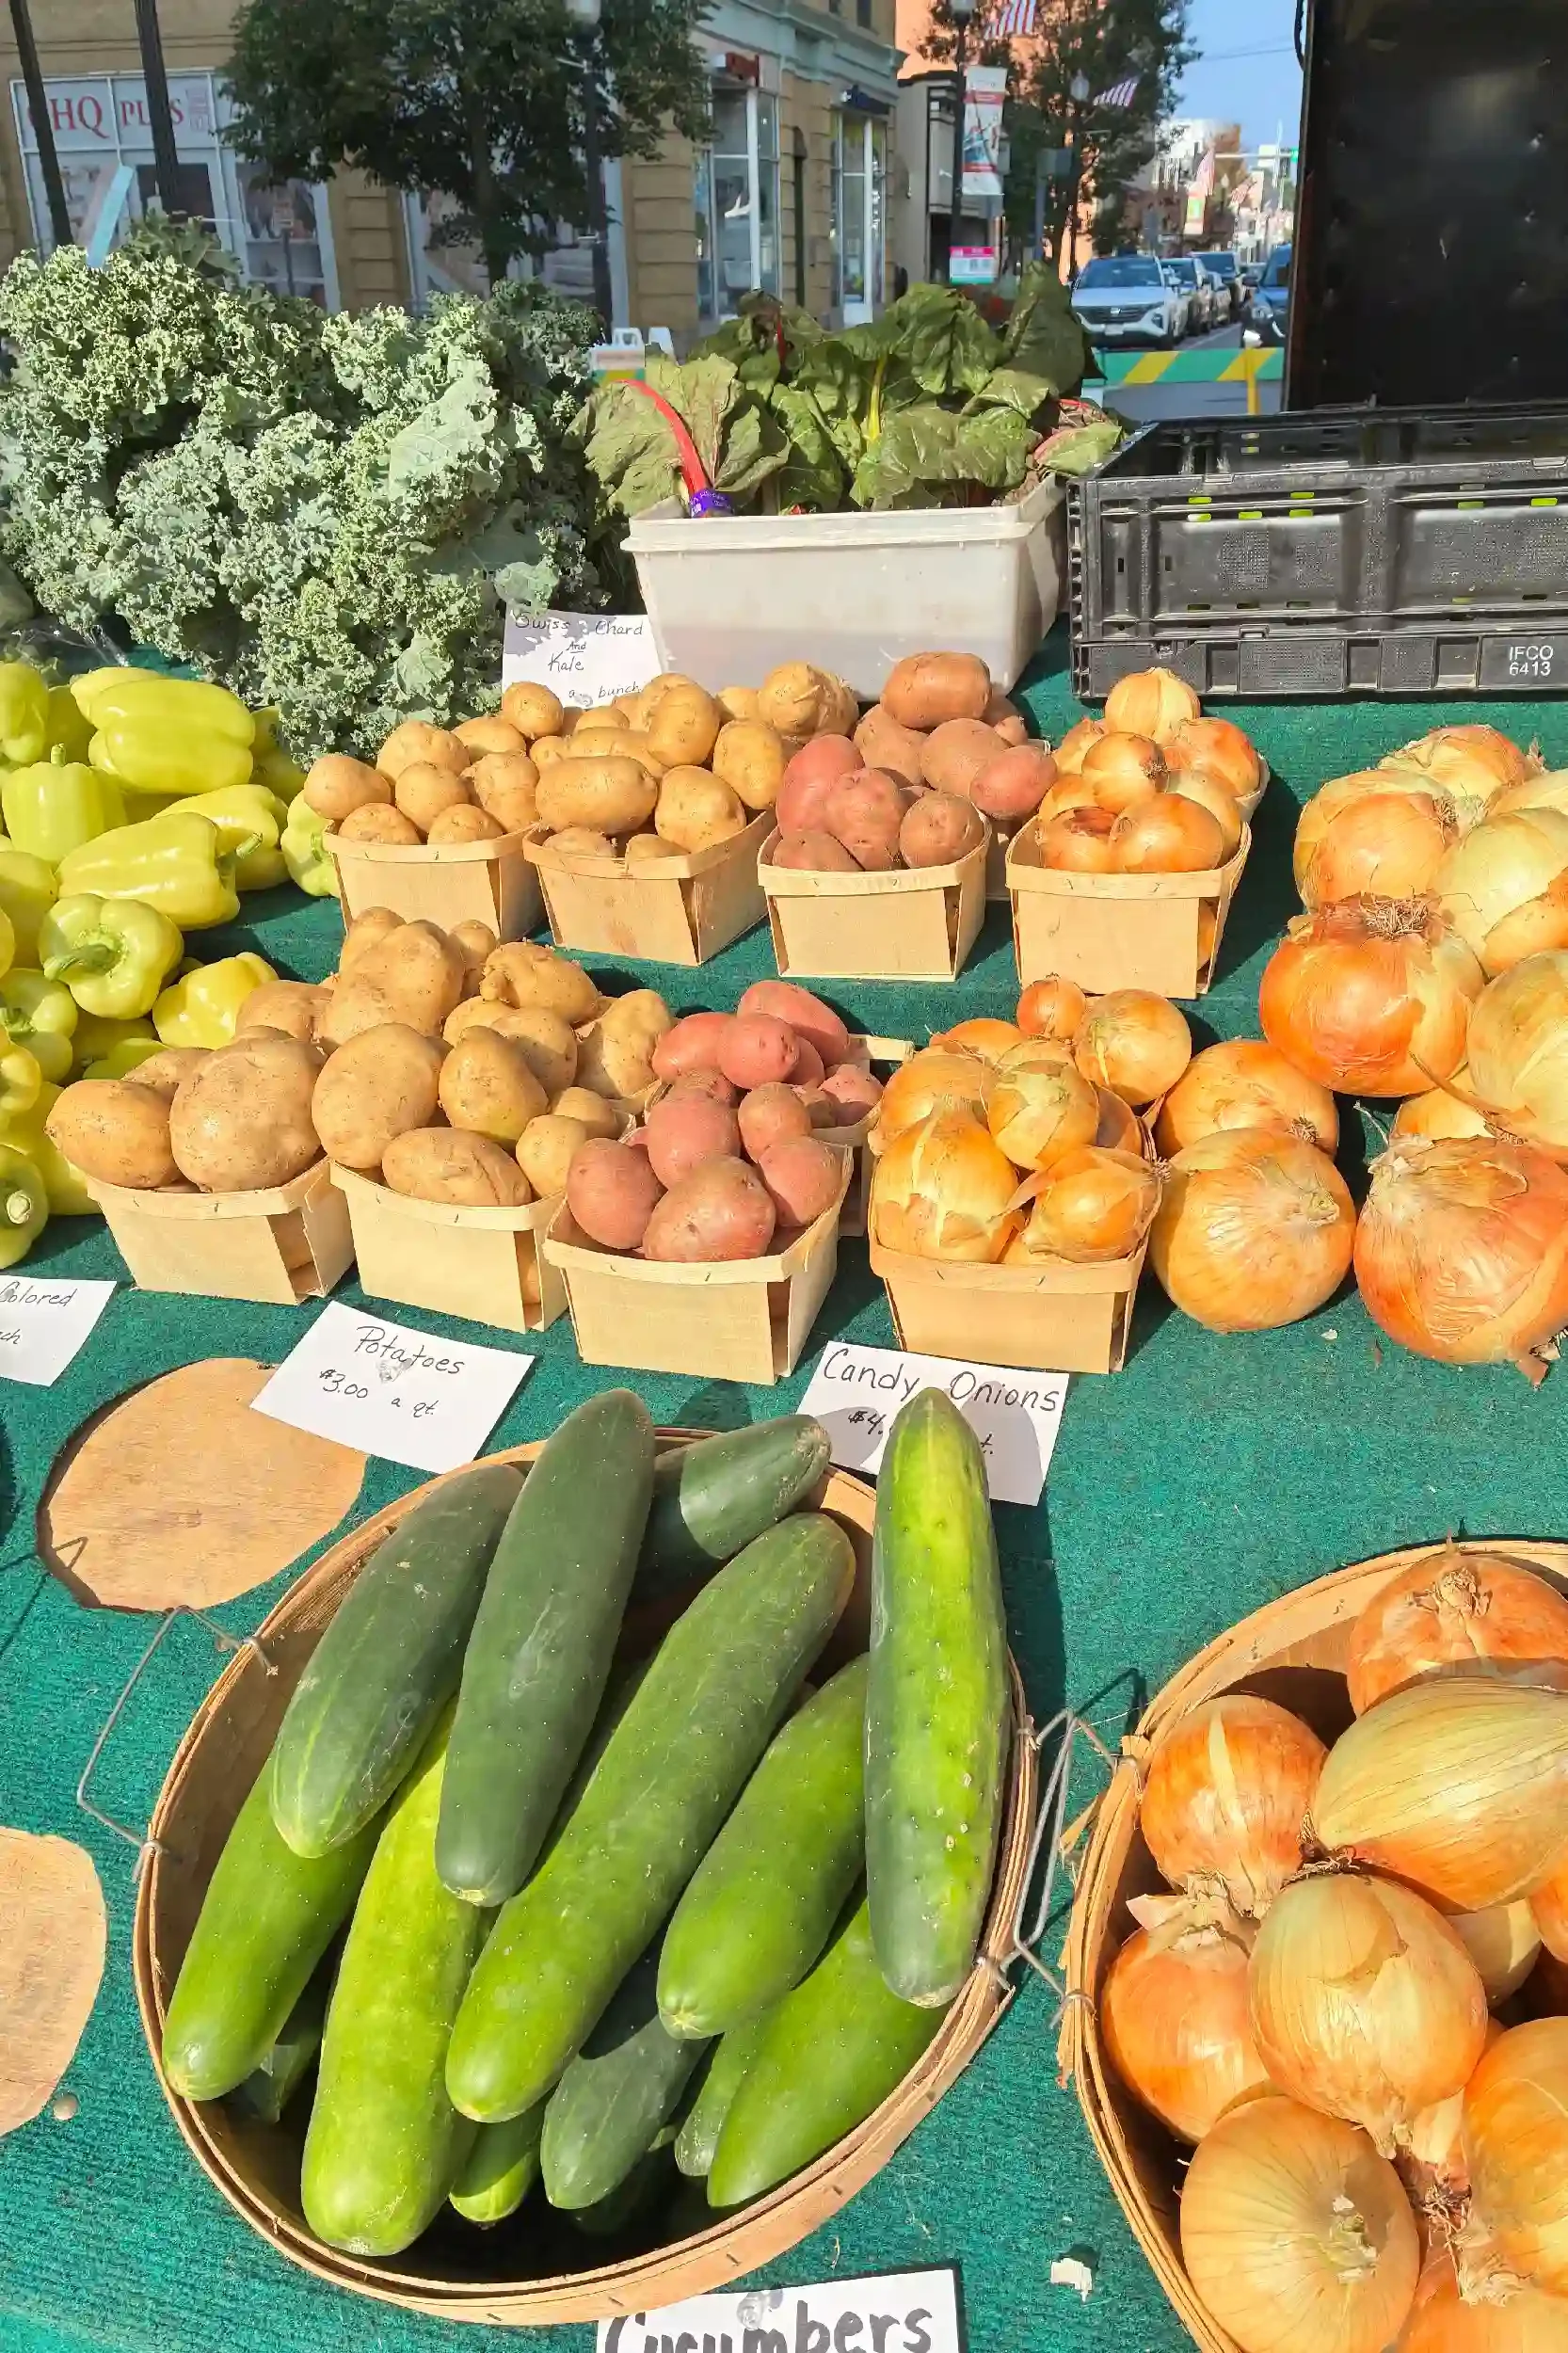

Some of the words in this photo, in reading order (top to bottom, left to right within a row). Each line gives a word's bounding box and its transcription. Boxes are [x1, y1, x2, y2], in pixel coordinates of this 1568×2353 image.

[28, 95, 110, 139] HQ
[120, 98, 184, 127] PLS
[515, 612, 570, 630] Swiss
[595, 617, 643, 635] Chard
[567, 641, 586, 652] And
[1509, 645, 1554, 661] IFCO
[548, 651, 584, 672] Kale
[1509, 661, 1551, 677] 6413
[354, 1325, 465, 1374] Potatoes
[319, 1369, 369, 1399] $3.00
[391, 1397, 401, 1407] a
[824, 1348, 920, 1401] Candy
[949, 1370, 1060, 1412] Onions
[847, 1410, 891, 1435] $4.
